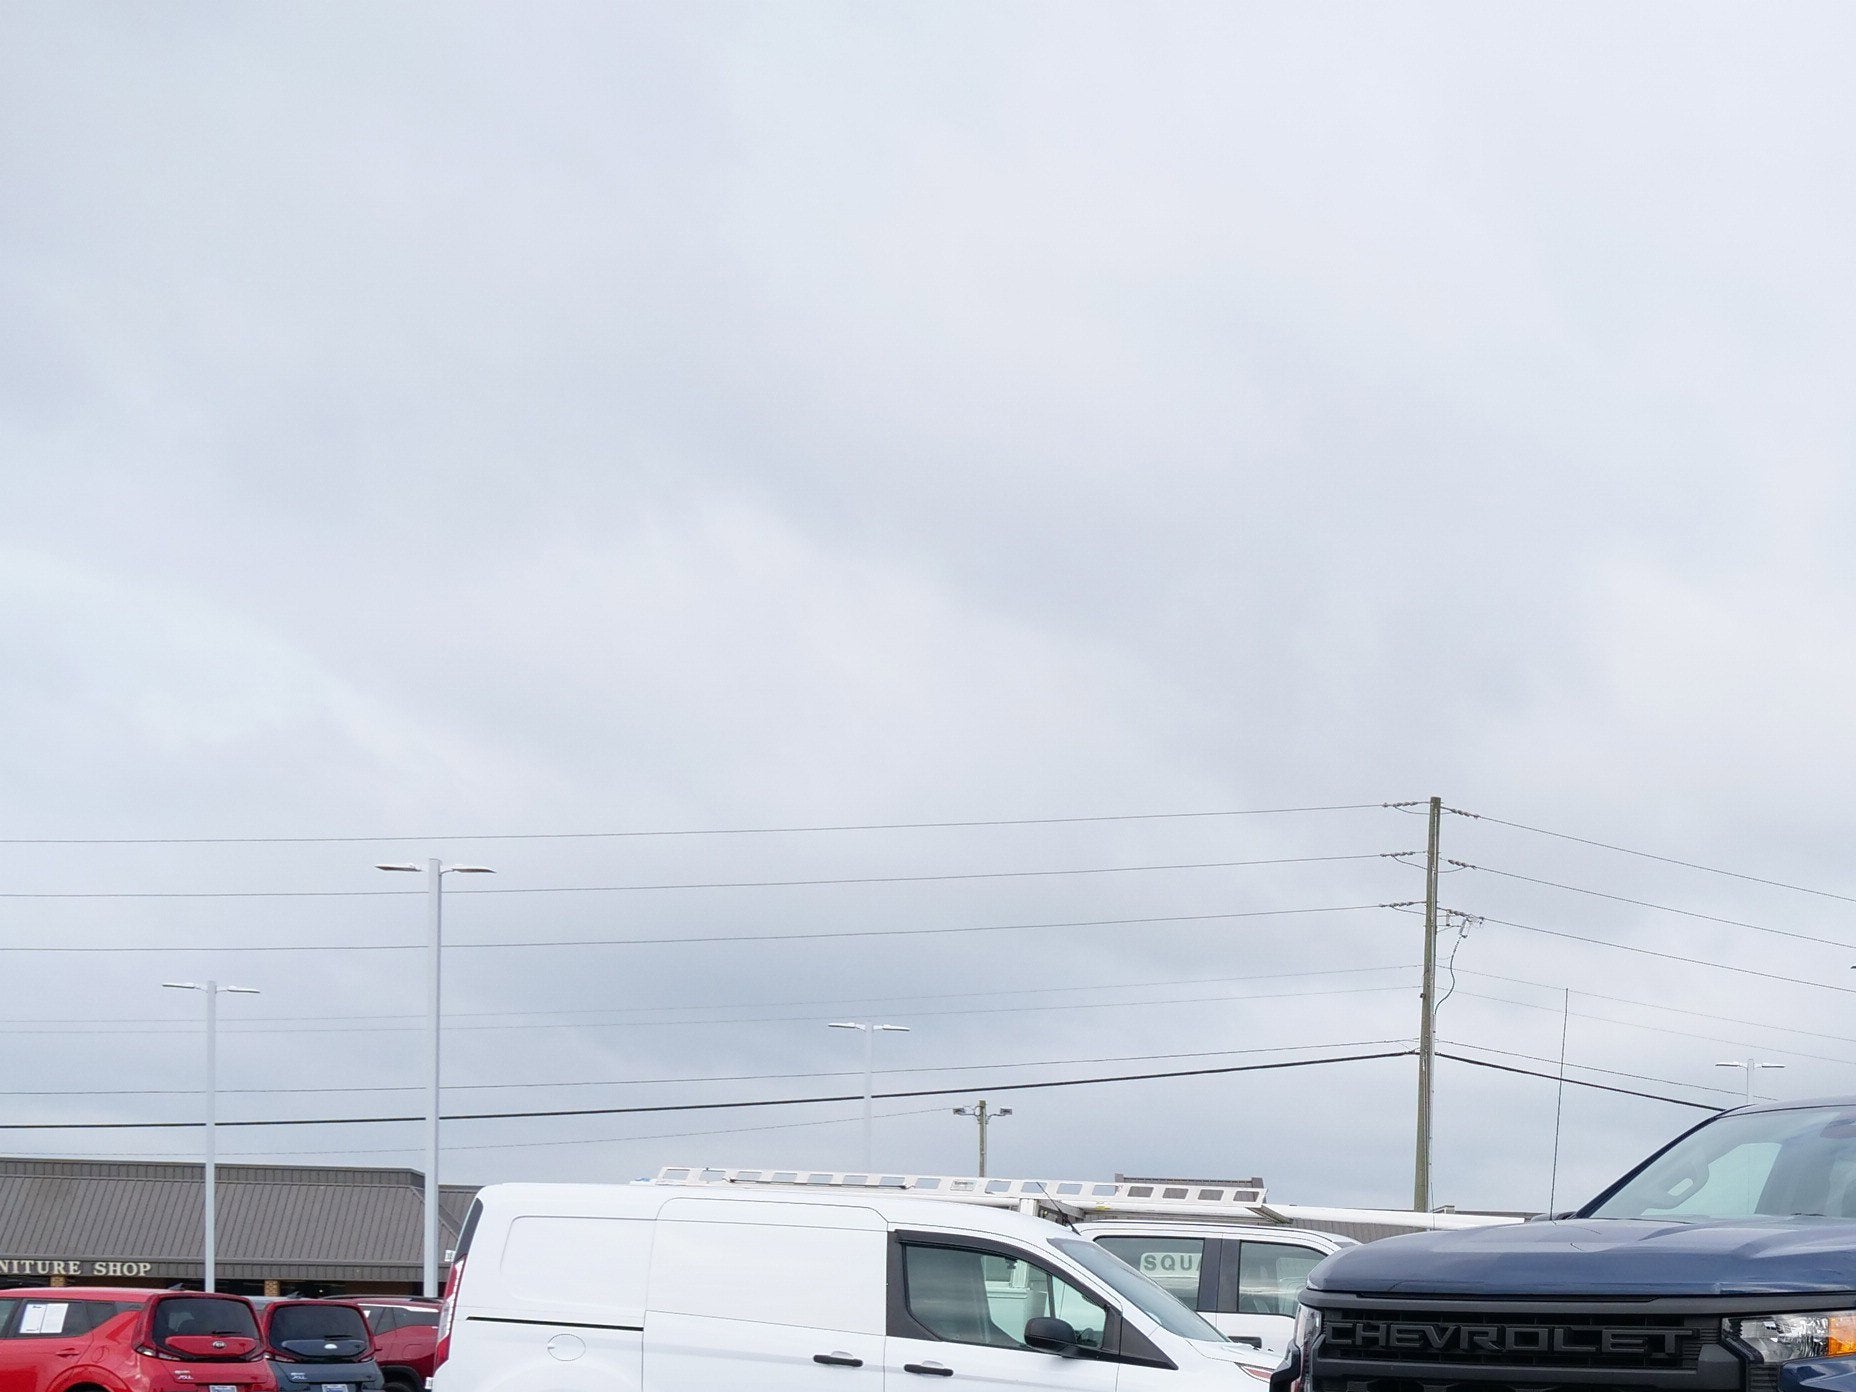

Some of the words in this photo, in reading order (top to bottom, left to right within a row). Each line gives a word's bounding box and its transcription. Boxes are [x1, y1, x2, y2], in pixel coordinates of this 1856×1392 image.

[93, 1262, 151, 1276] SHOP
[1143, 1254, 1201, 1271] SQU
[1325, 1321, 1694, 1354] CHEVROLET
